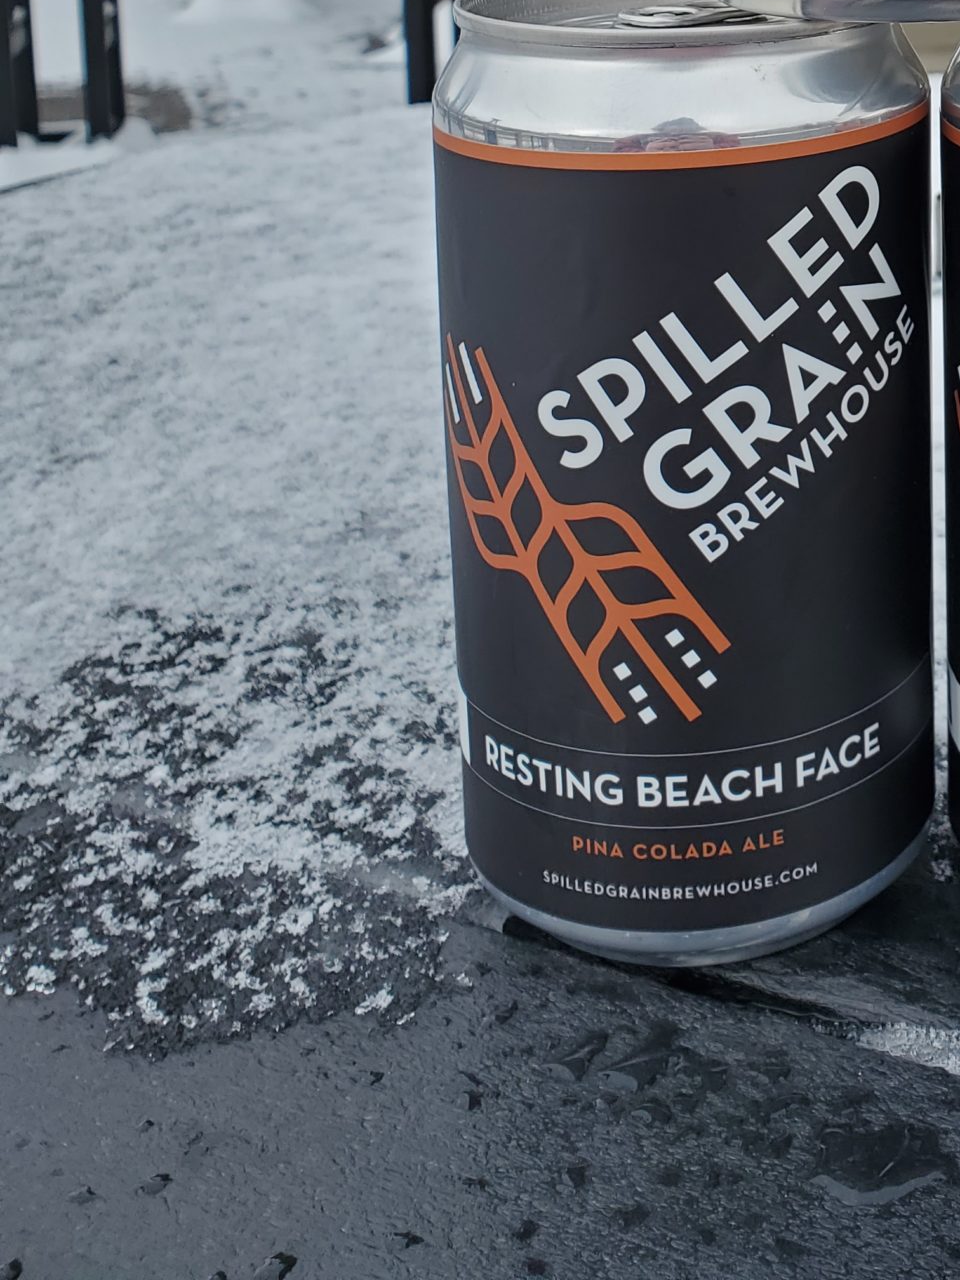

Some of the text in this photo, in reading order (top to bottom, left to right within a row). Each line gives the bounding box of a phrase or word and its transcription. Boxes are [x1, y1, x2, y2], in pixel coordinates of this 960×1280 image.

[537, 165, 880, 470] SPILLED
[688, 304, 915, 563] BREWHOUSE
[484, 722, 881, 808] RESTING BEACH FACE
[542, 861, 819, 900] SPILLEDGRAINBREWHOUSE.COM
[572, 829, 785, 860] PINA COLADA ALE
